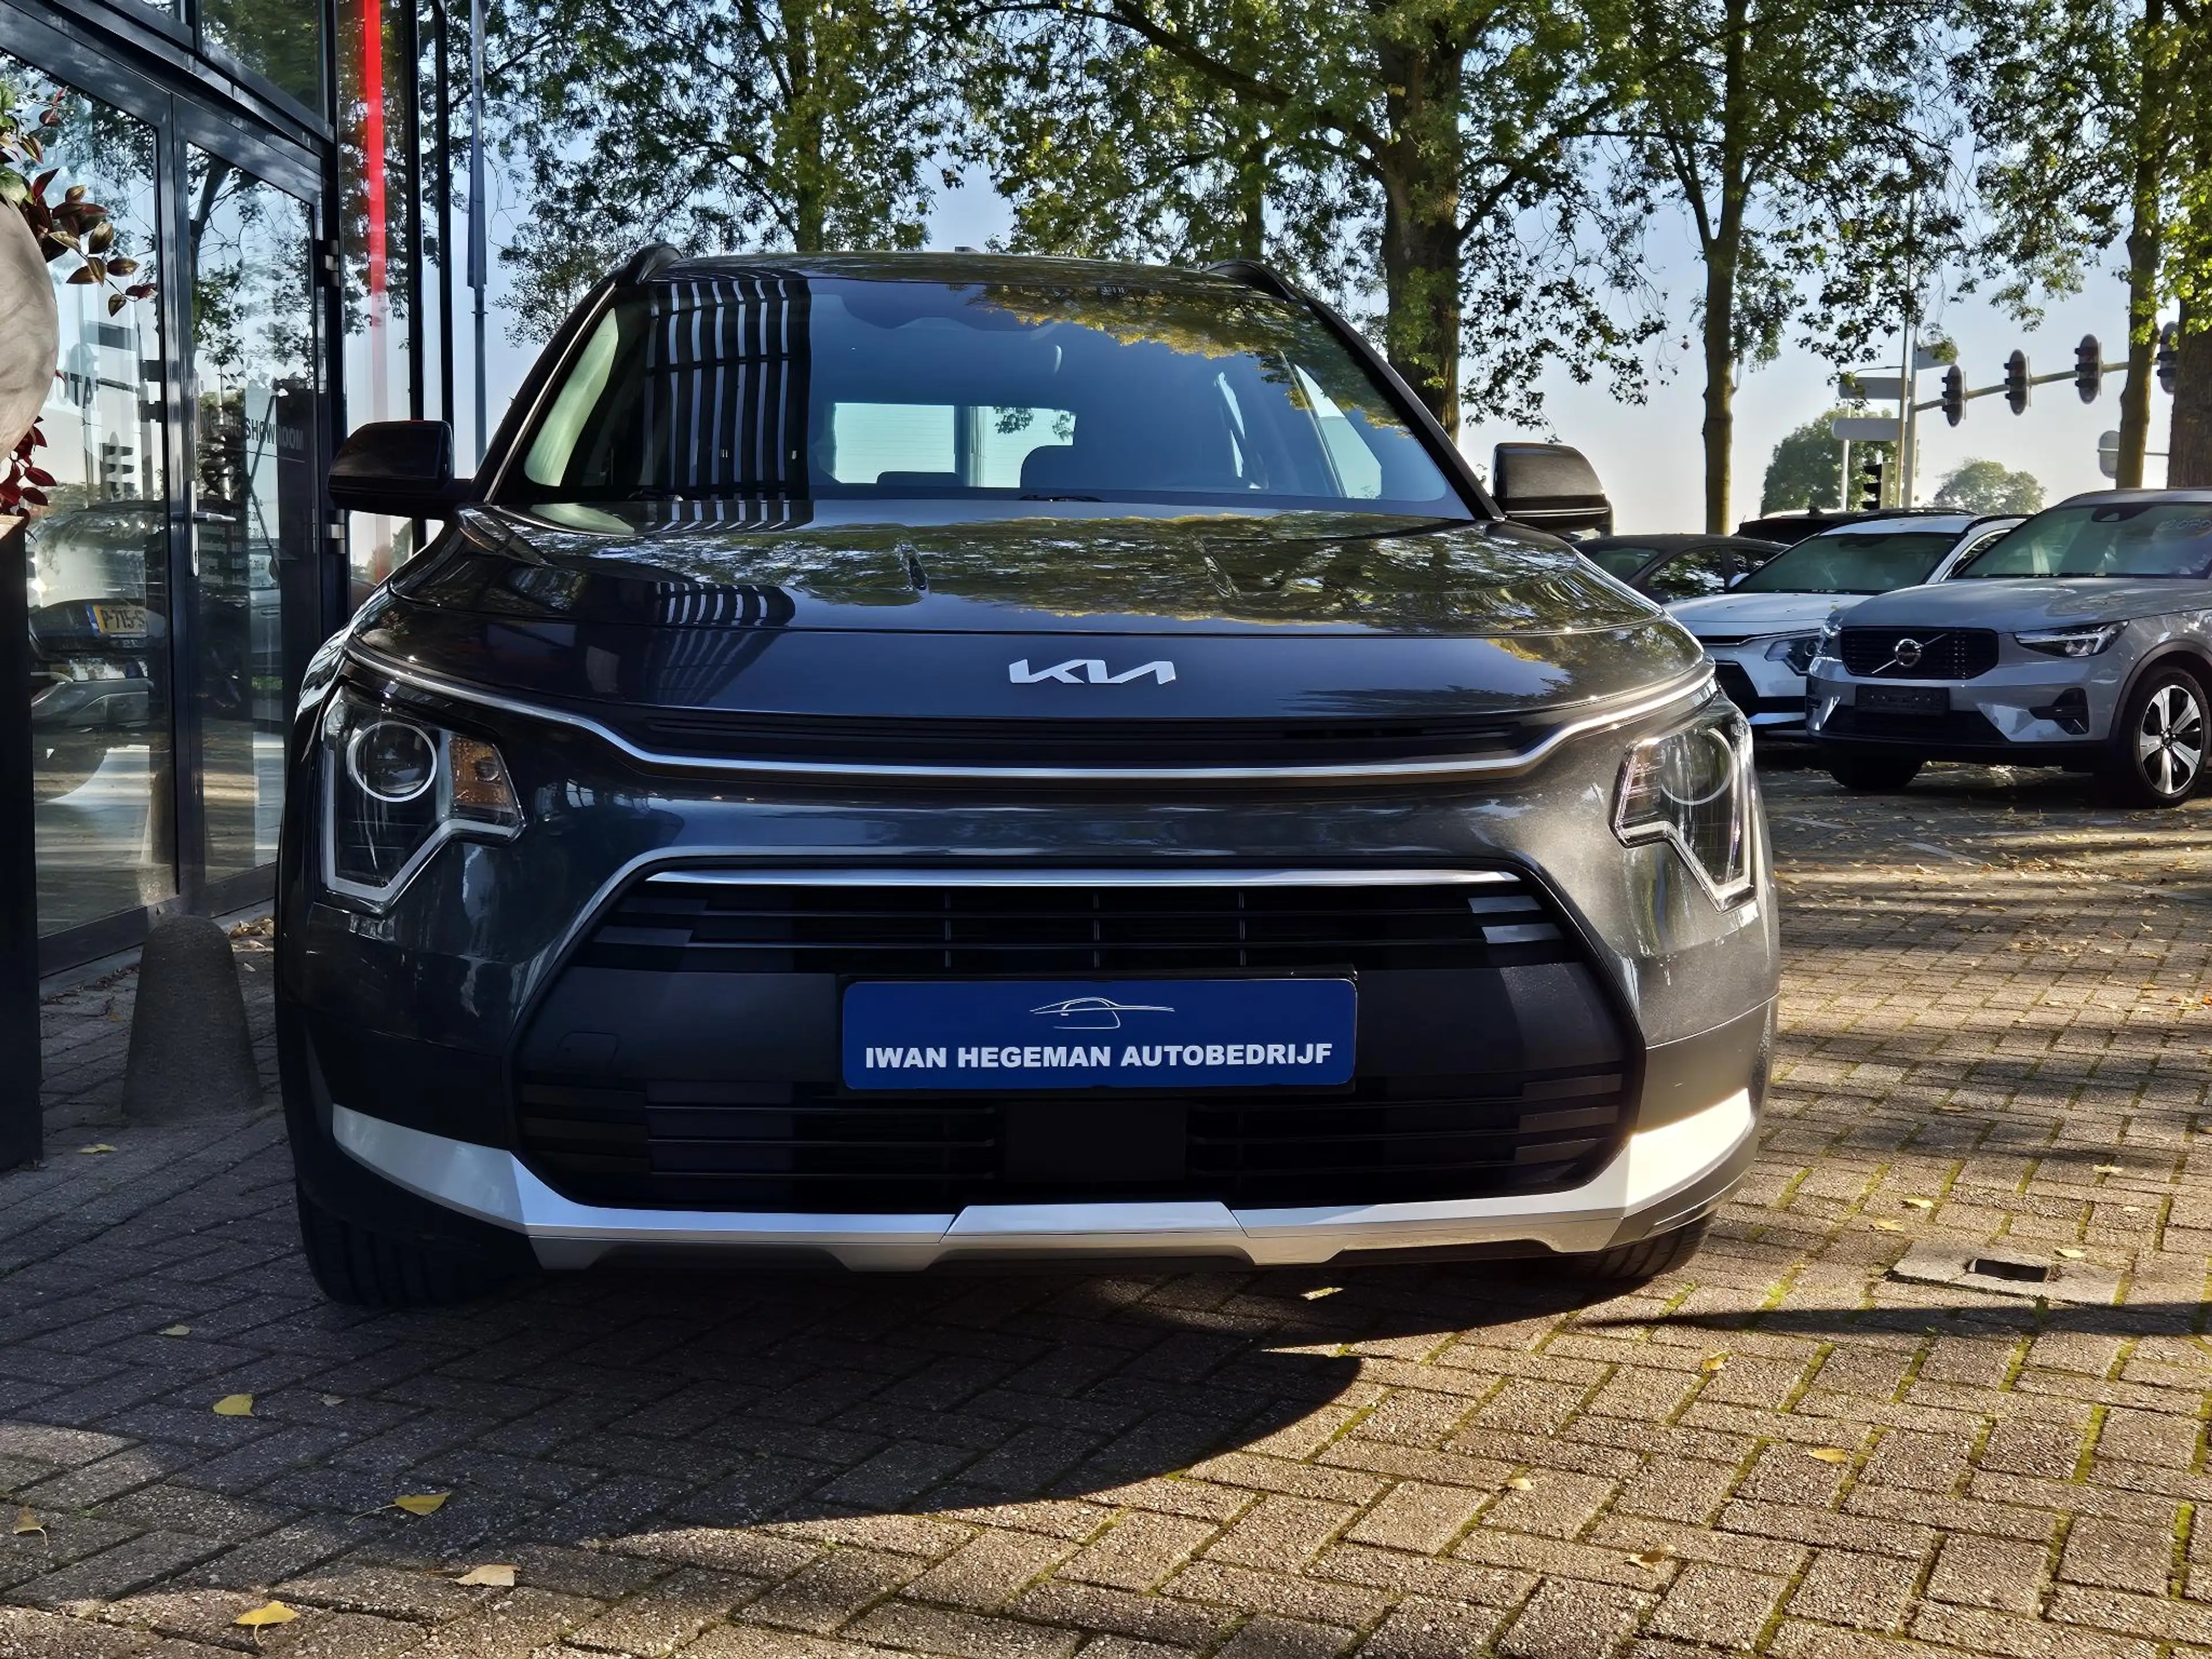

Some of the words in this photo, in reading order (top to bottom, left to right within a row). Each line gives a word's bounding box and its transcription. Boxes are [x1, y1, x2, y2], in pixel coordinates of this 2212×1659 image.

[243, 418, 304, 450] SHOWROOM
[1009, 659, 1176, 684] KIA
[865, 1047, 947, 1069] IWAN
[957, 1046, 1112, 1068] HEGEMAN
[1120, 1043, 1333, 1066] AUTOBEDRIJF
